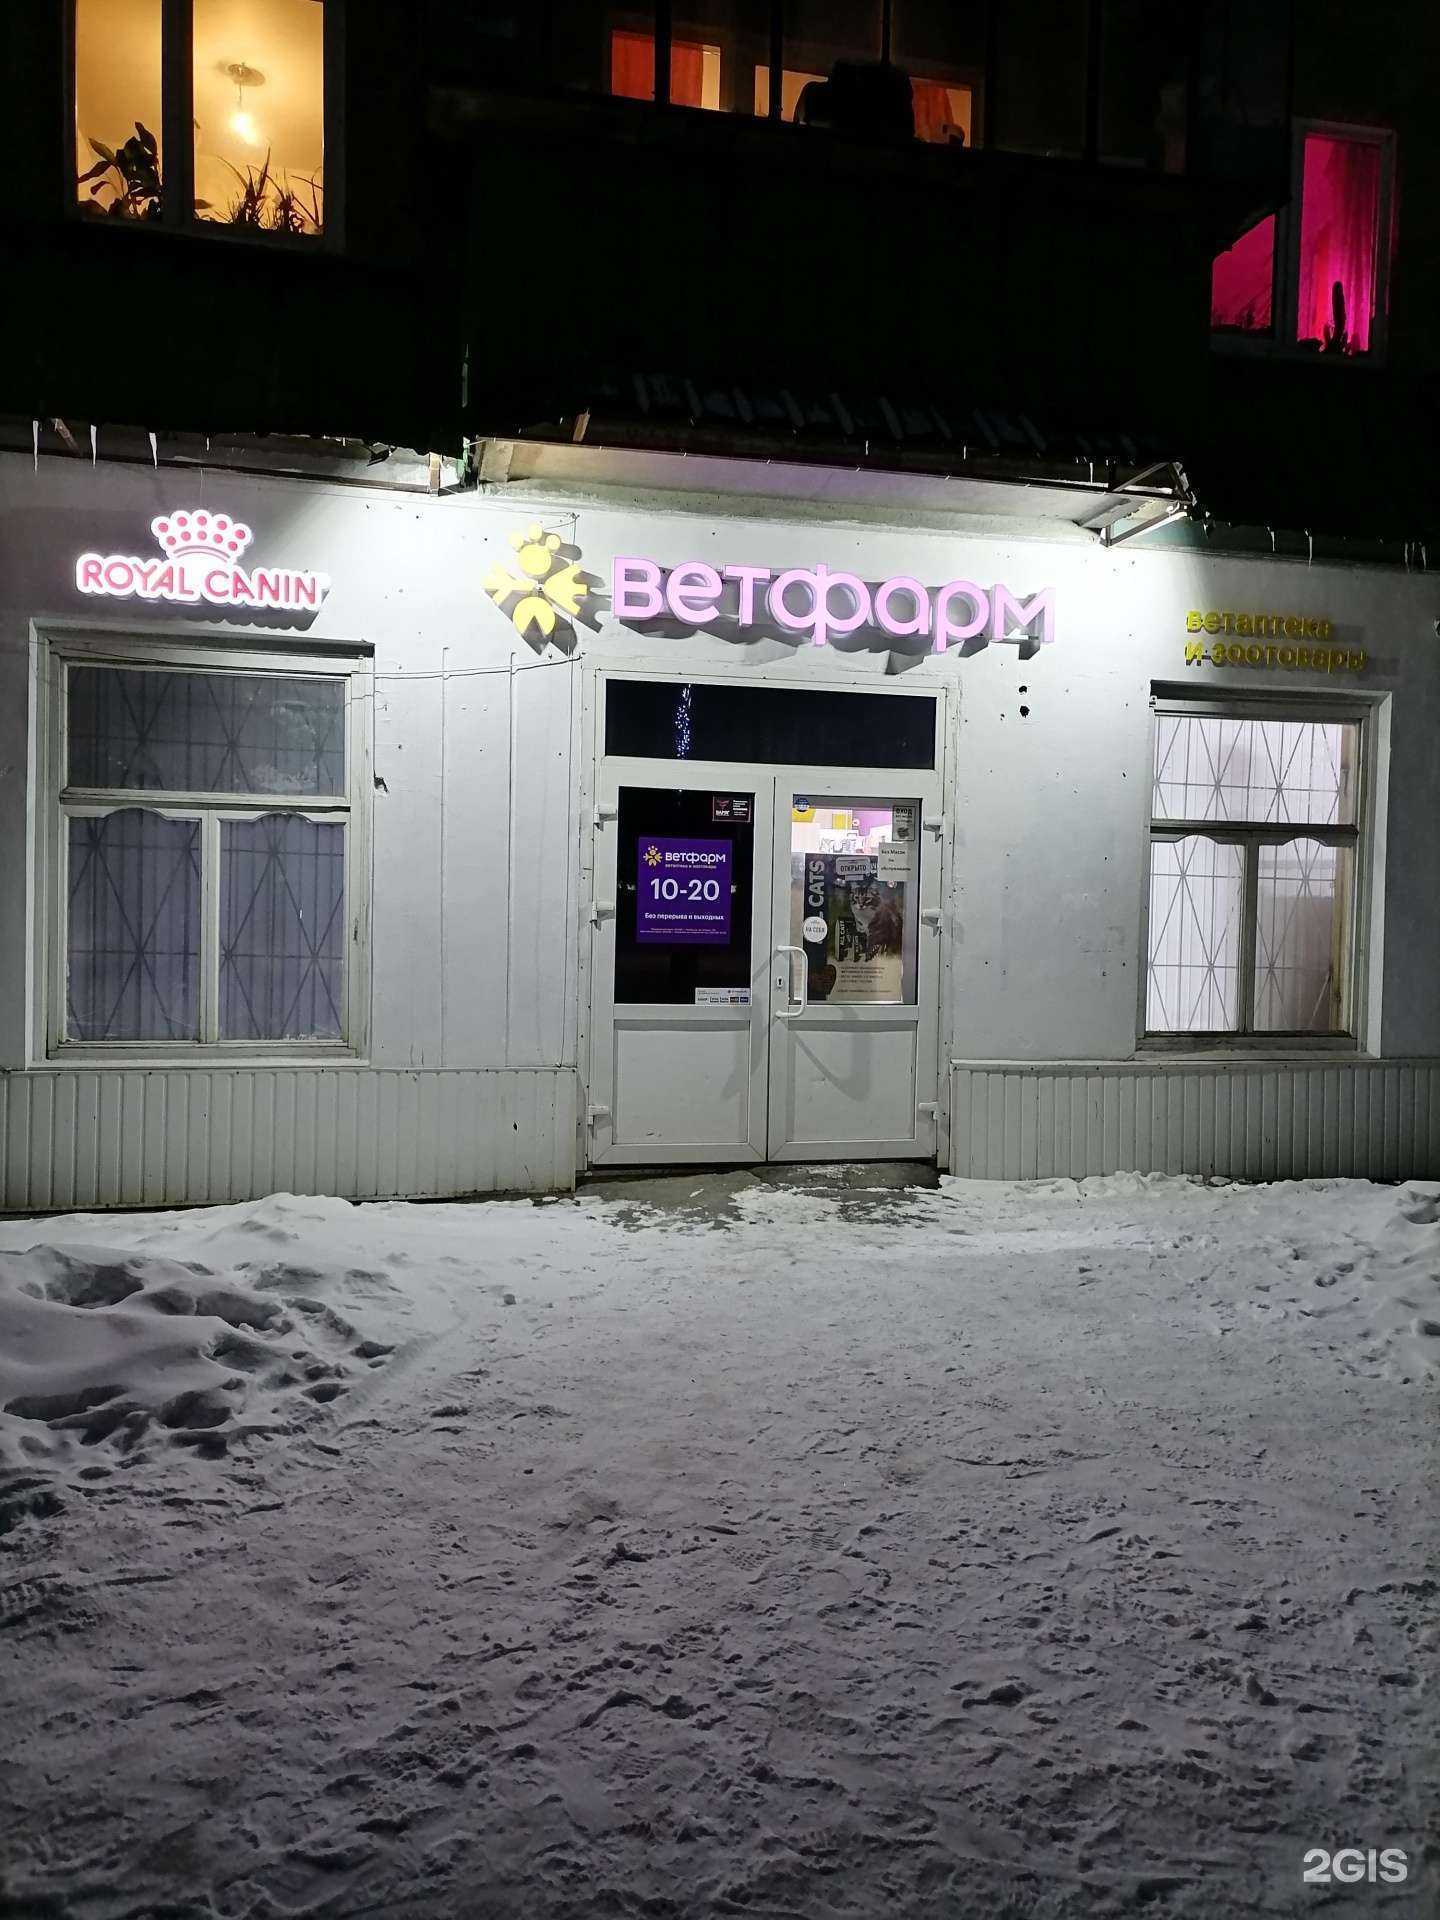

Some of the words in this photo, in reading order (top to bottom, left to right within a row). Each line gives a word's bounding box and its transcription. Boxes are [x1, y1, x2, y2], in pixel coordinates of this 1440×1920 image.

[82, 559, 195, 596] ROYAL
[204, 569, 317, 605] CANIN
[808, 860, 825, 907] CATS
[840, 864, 867, 872] ОТКРЫТО
[650, 878, 720, 901] 10-20
